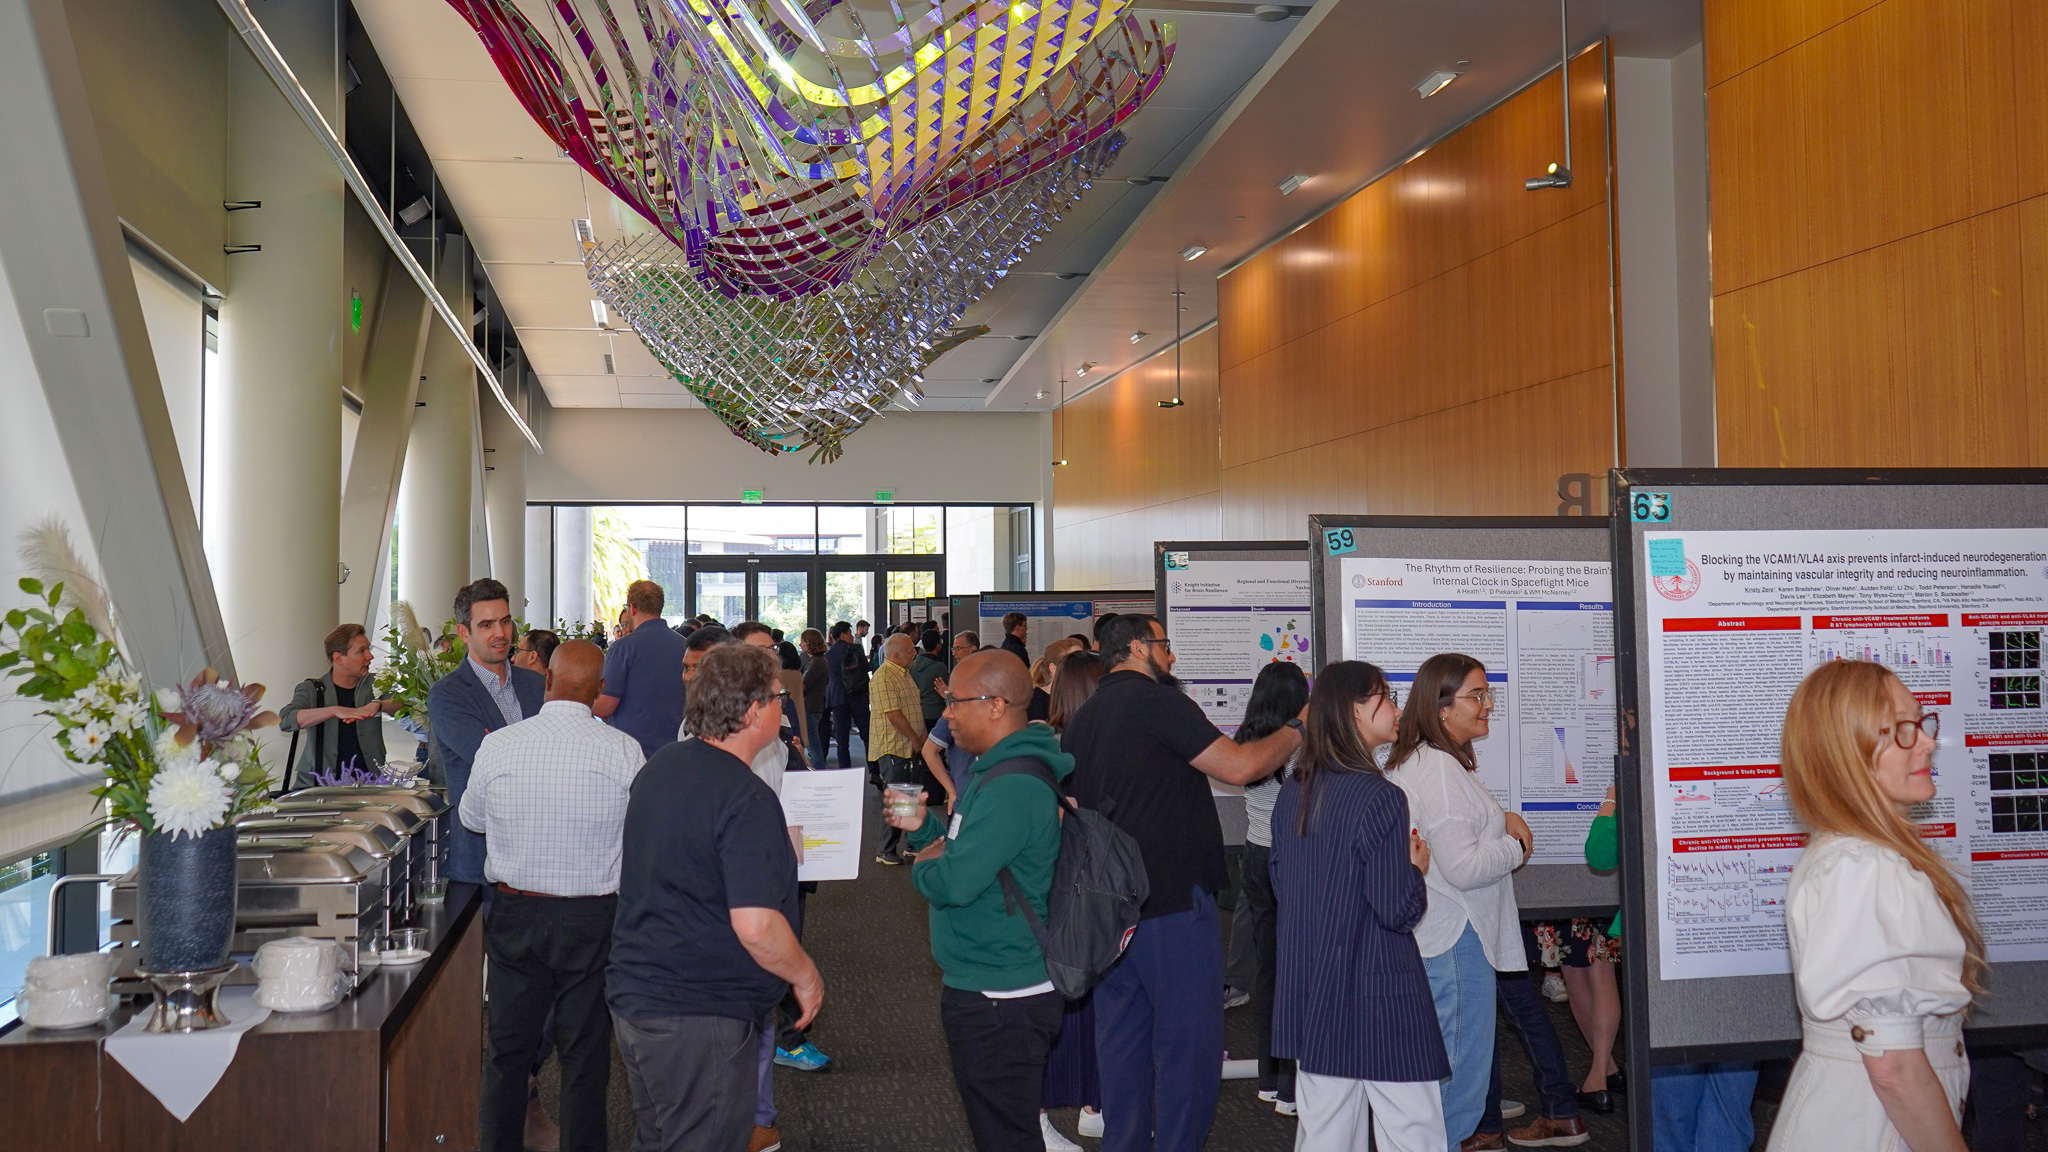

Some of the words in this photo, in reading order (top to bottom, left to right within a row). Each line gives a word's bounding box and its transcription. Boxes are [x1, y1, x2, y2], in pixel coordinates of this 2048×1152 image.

[876, 492, 892, 500] EXIT
[1634, 494, 1670, 520] 63
[1328, 529, 1354, 550] 59
[1702, 555, 1743, 568] Blocking
[1746, 555, 1761, 564] the
[1763, 553, 1824, 564] VCAM1/VLA4
[1827, 553, 1846, 564] axis
[1848, 553, 1888, 566] prevents
[1890, 552, 1960, 564] infarct-induced
[1963, 551, 2047, 564] neurodegeneration
[1405, 564, 1422, 572] The
[1425, 564, 1461, 574] Rhythm
[1464, 564, 1472, 573] of
[1475, 565, 1526, 574] Resilience:
[1528, 566, 1564, 576] Probing
[1566, 566, 1582, 575] the
[1584, 567, 1612, 576] Brain's
[1724, 570, 1735, 582] by
[1738, 570, 1792, 582] maintaining
[1795, 570, 1834, 580] vascular
[1837, 568, 1874, 582] integrity
[1877, 568, 1895, 578] and
[1897, 568, 1938, 580] reducing
[1940, 567, 2028, 578] neuroinflammation.
[1368, 578, 1403, 586] Stanford
[1433, 577, 1468, 586] Internal
[1472, 577, 1498, 586] Clock
[1500, 578, 1508, 586] in
[1511, 578, 1564, 588] Spaceflight
[1566, 578, 1590, 588] Mice
